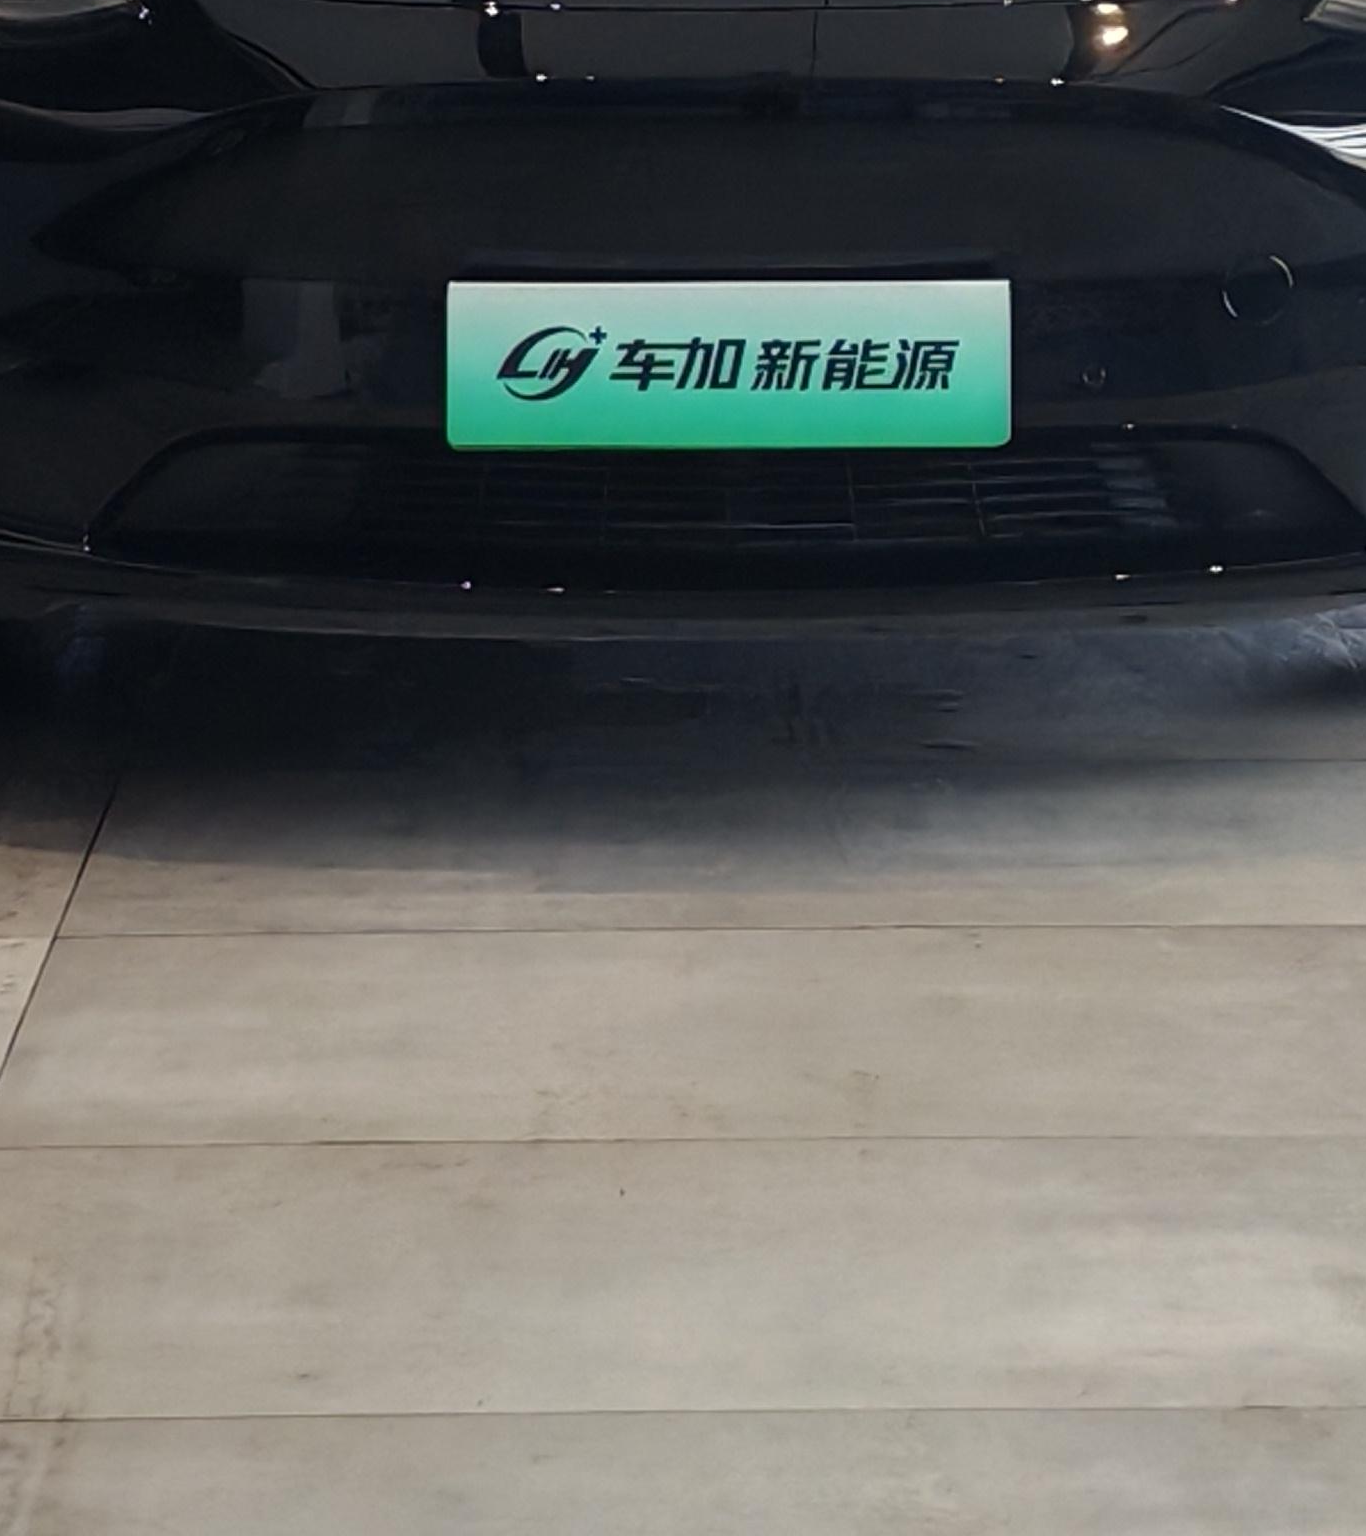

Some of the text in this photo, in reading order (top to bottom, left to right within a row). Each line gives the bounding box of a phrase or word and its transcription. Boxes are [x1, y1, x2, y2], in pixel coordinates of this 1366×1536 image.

[609, 337, 960, 392] 车加新能源
